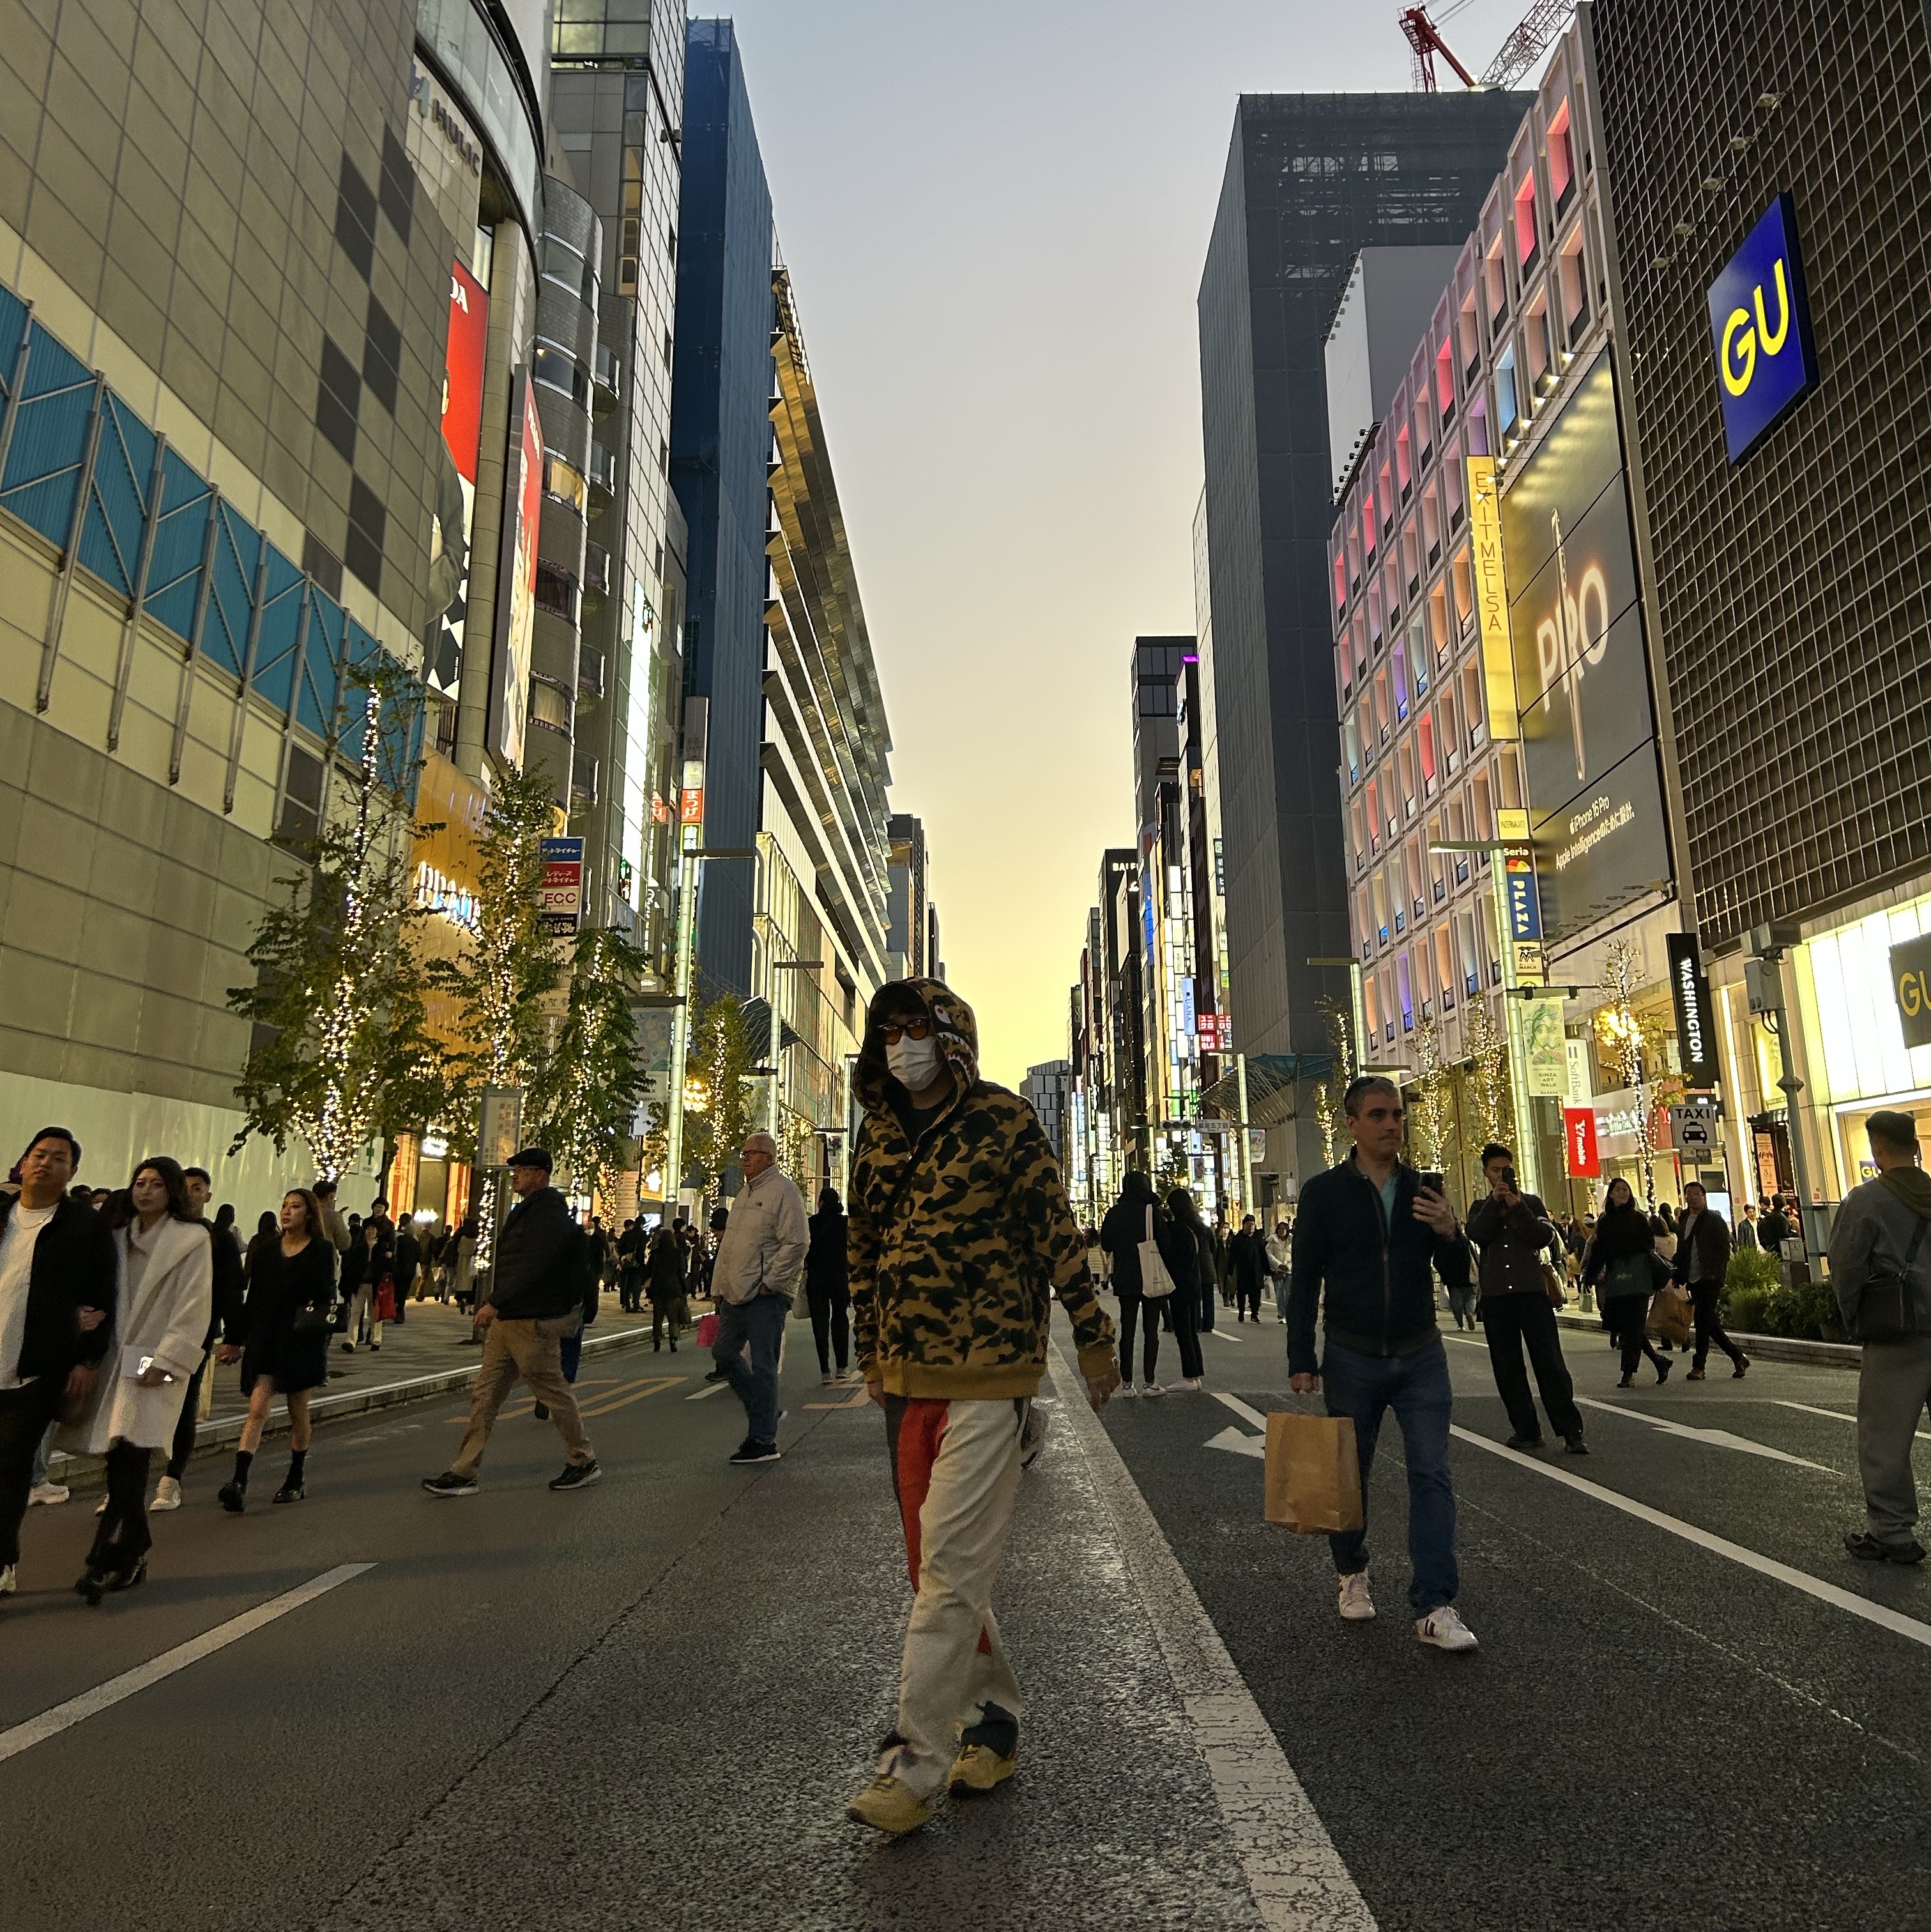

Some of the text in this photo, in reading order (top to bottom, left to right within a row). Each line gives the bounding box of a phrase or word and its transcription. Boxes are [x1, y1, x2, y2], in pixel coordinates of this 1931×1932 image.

[432, 98, 480, 178] HULIC
[1721, 258, 1789, 396] GU
[1475, 471, 1502, 631] EXITMELSA
[1573, 796, 1610, 832] iPhone 16 Pro
[1503, 847, 1529, 856] Seria
[1556, 848, 1571, 870] Apple
[544, 893, 577, 904] ECC
[1513, 880, 1530, 934] PLAZA
[1185, 997, 1193, 1022] DIANA
[1679, 957, 1704, 1062] WASHINGTON
[1569, 1061, 1583, 1105] SoftBank
[1675, 1108, 1710, 1119] TAXI
[1575, 1119, 1587, 1166] Y!mobile
